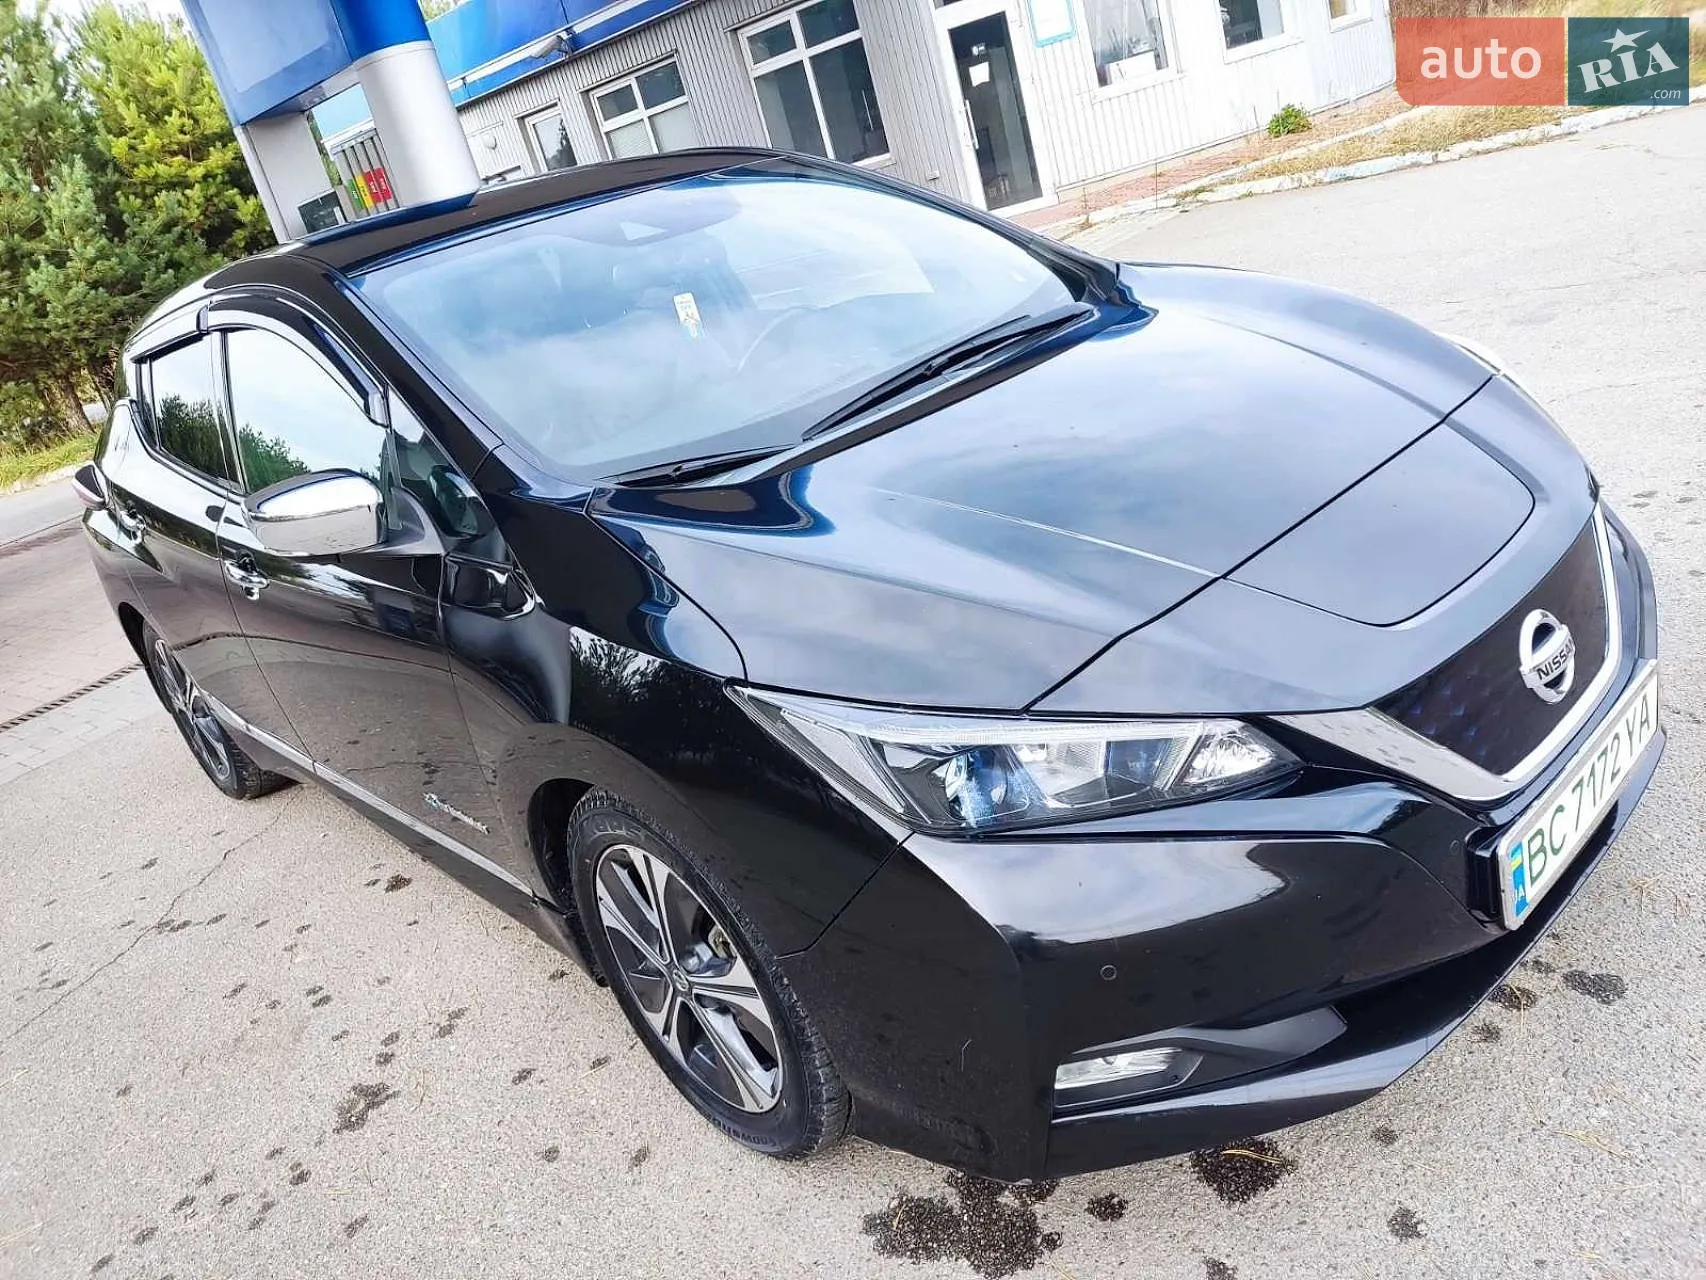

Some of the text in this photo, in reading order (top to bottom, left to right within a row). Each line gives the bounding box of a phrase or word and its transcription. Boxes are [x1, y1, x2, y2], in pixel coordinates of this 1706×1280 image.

[1527, 693, 1651, 886] BC 7172 YA
